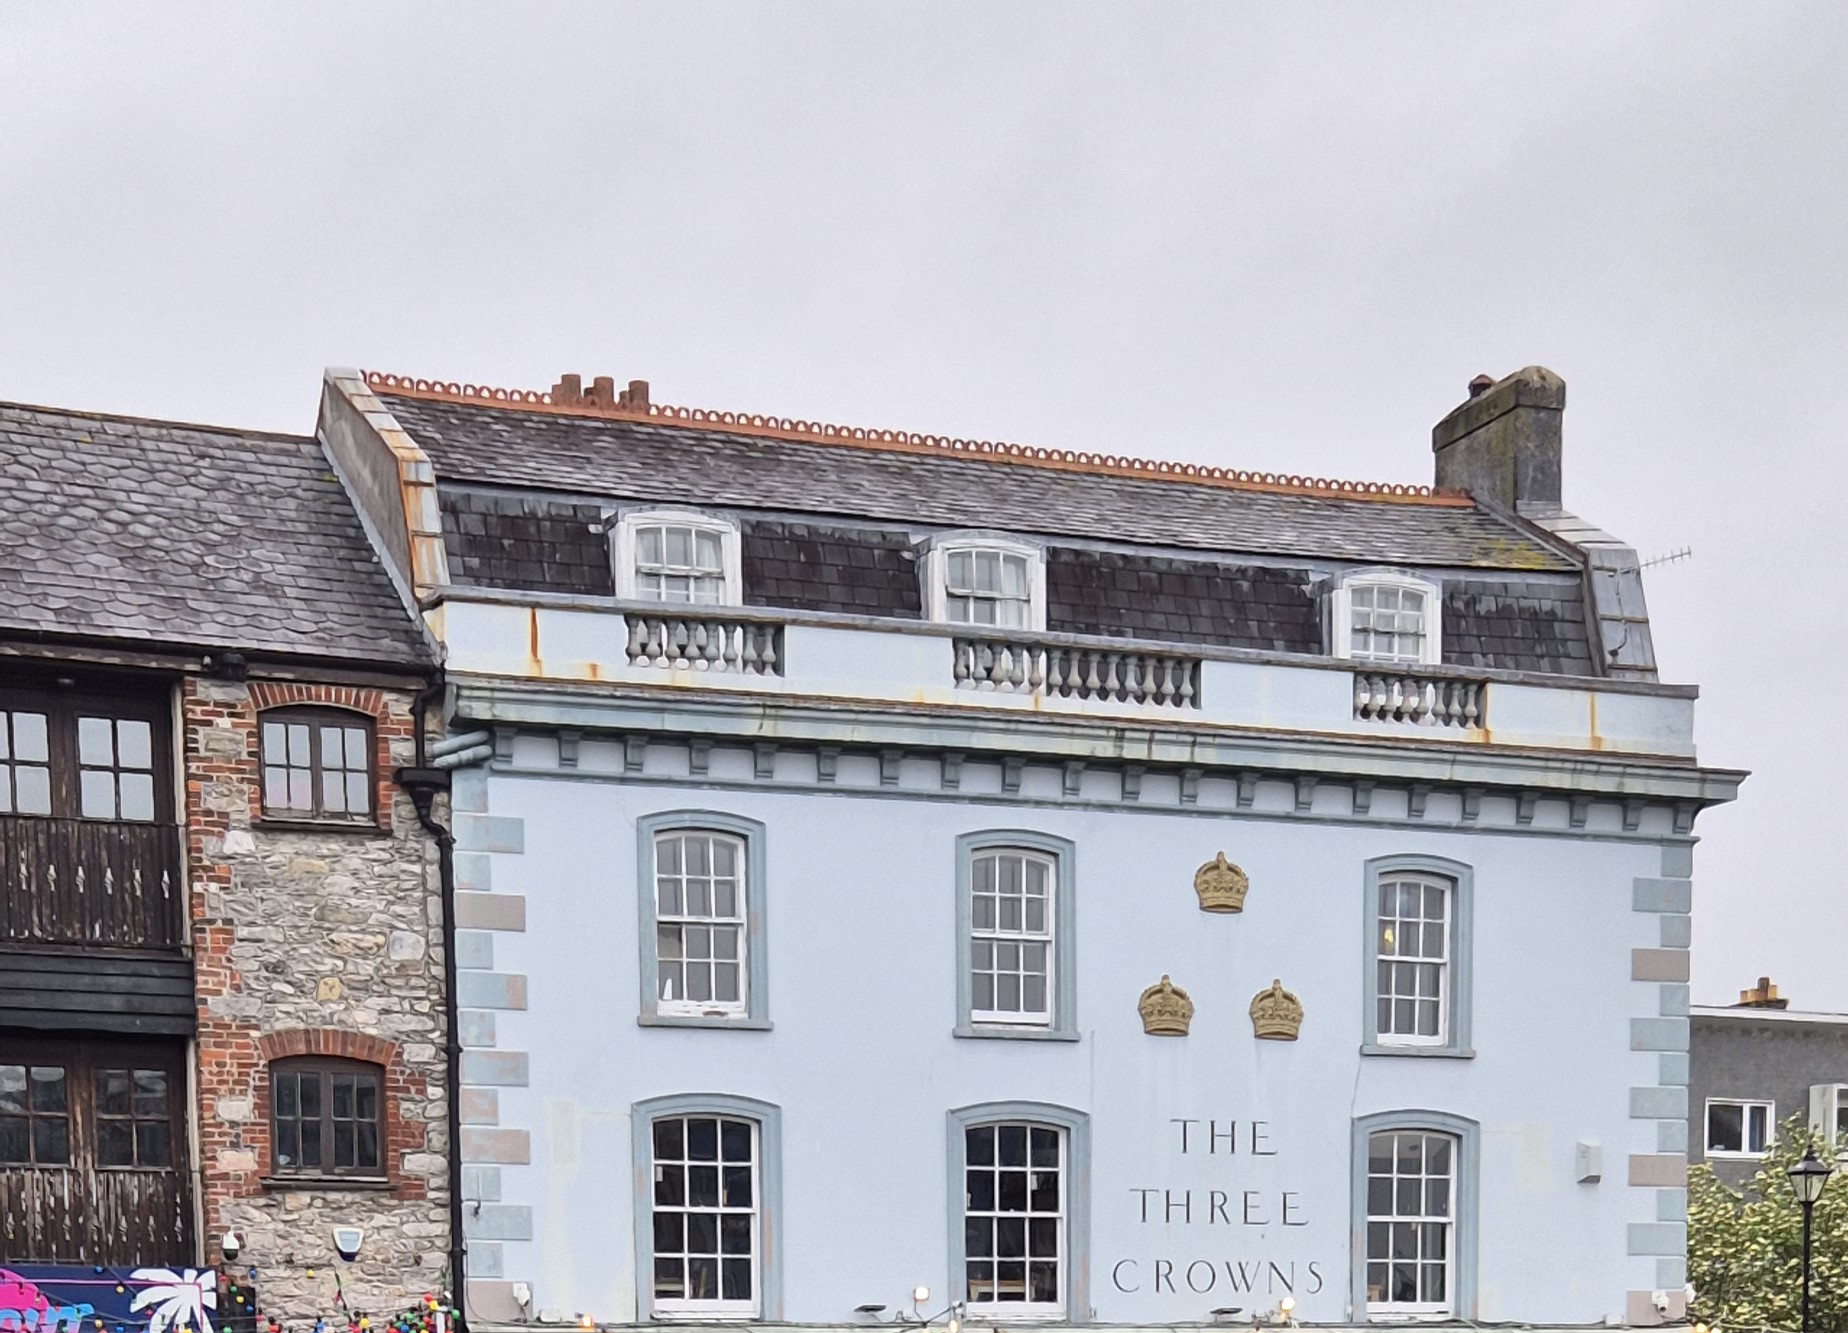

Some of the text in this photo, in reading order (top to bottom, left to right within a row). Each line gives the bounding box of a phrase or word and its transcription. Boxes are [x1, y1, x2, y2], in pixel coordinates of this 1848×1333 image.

[1170, 1118, 1278, 1156] THE
[1129, 1188, 1309, 1226] THREE
[1112, 1258, 1323, 1294] CROWNS
